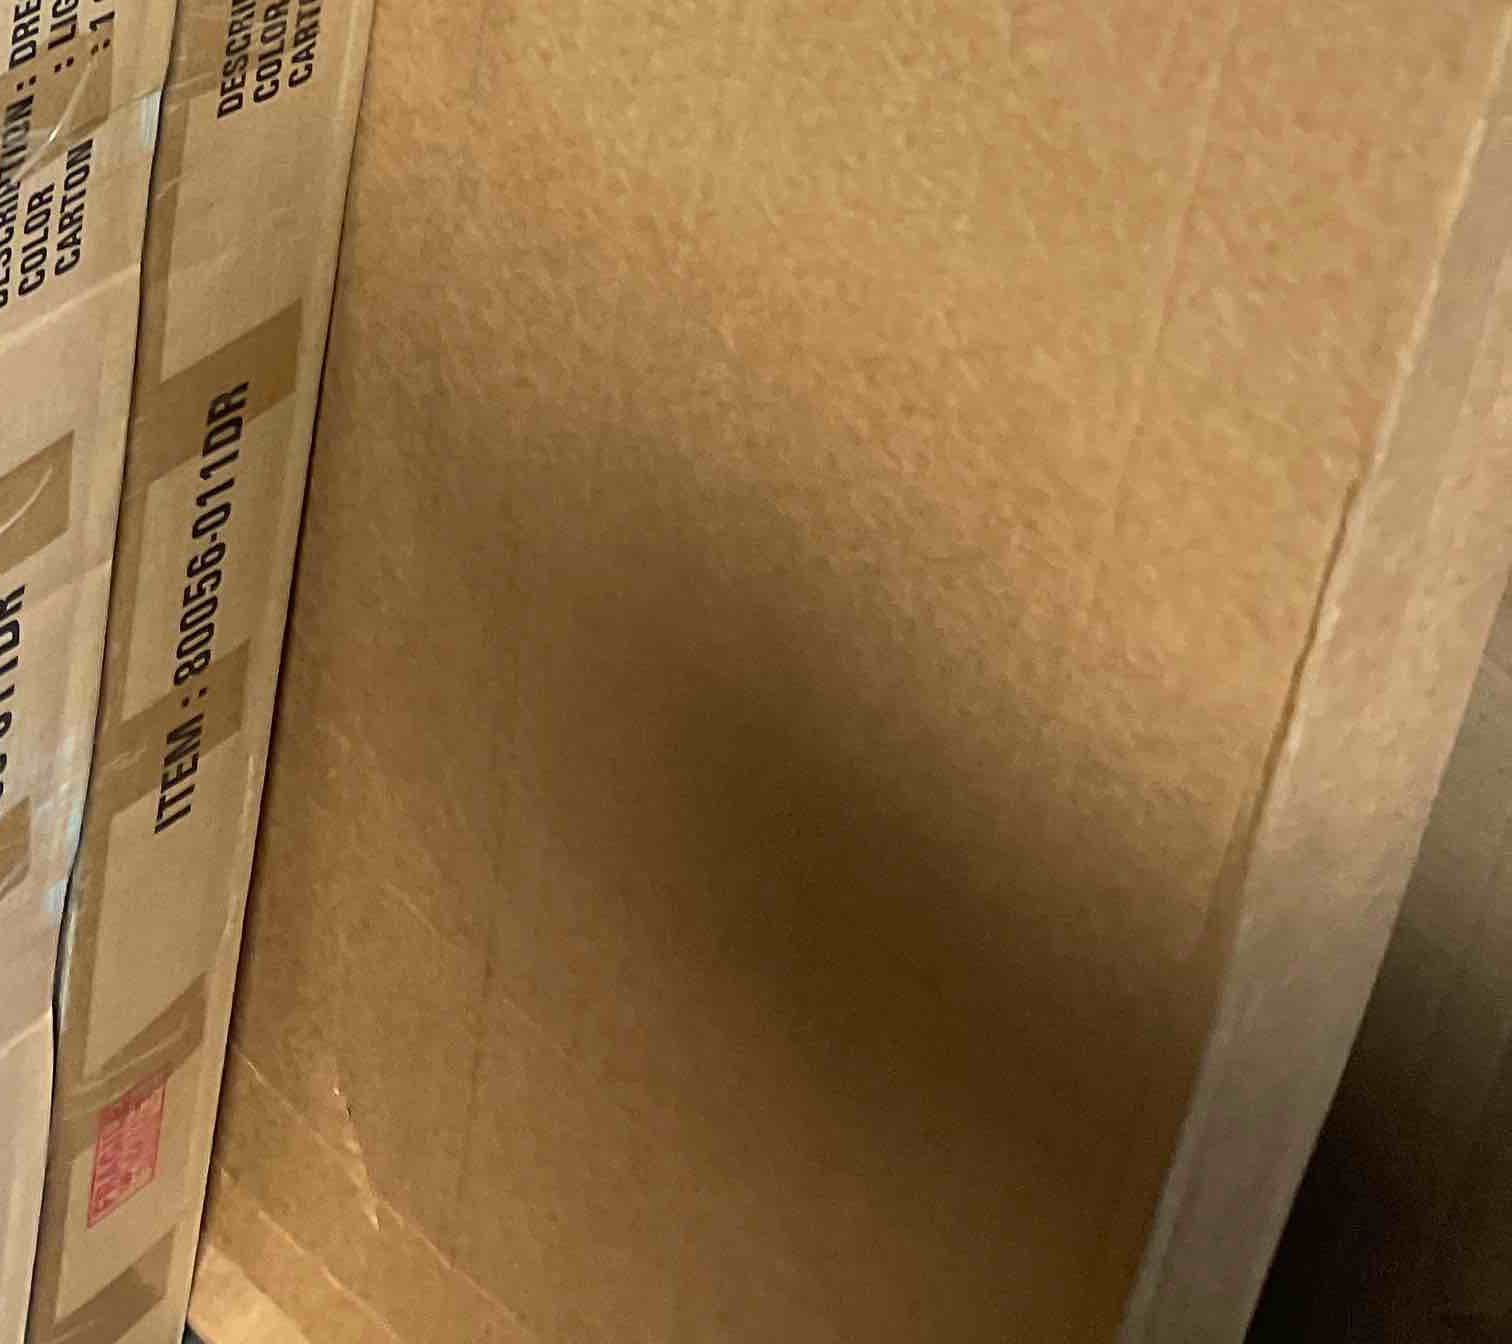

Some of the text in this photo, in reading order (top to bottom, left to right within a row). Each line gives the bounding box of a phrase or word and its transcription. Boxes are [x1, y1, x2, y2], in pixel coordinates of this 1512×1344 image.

[55, 139, 93, 276] CARTON
[90, 11, 115, 32] 1
[18, 184, 54, 296] COLOR
[174, 382, 248, 686] 80056-011DR
[154, 714, 203, 834] ITEM
